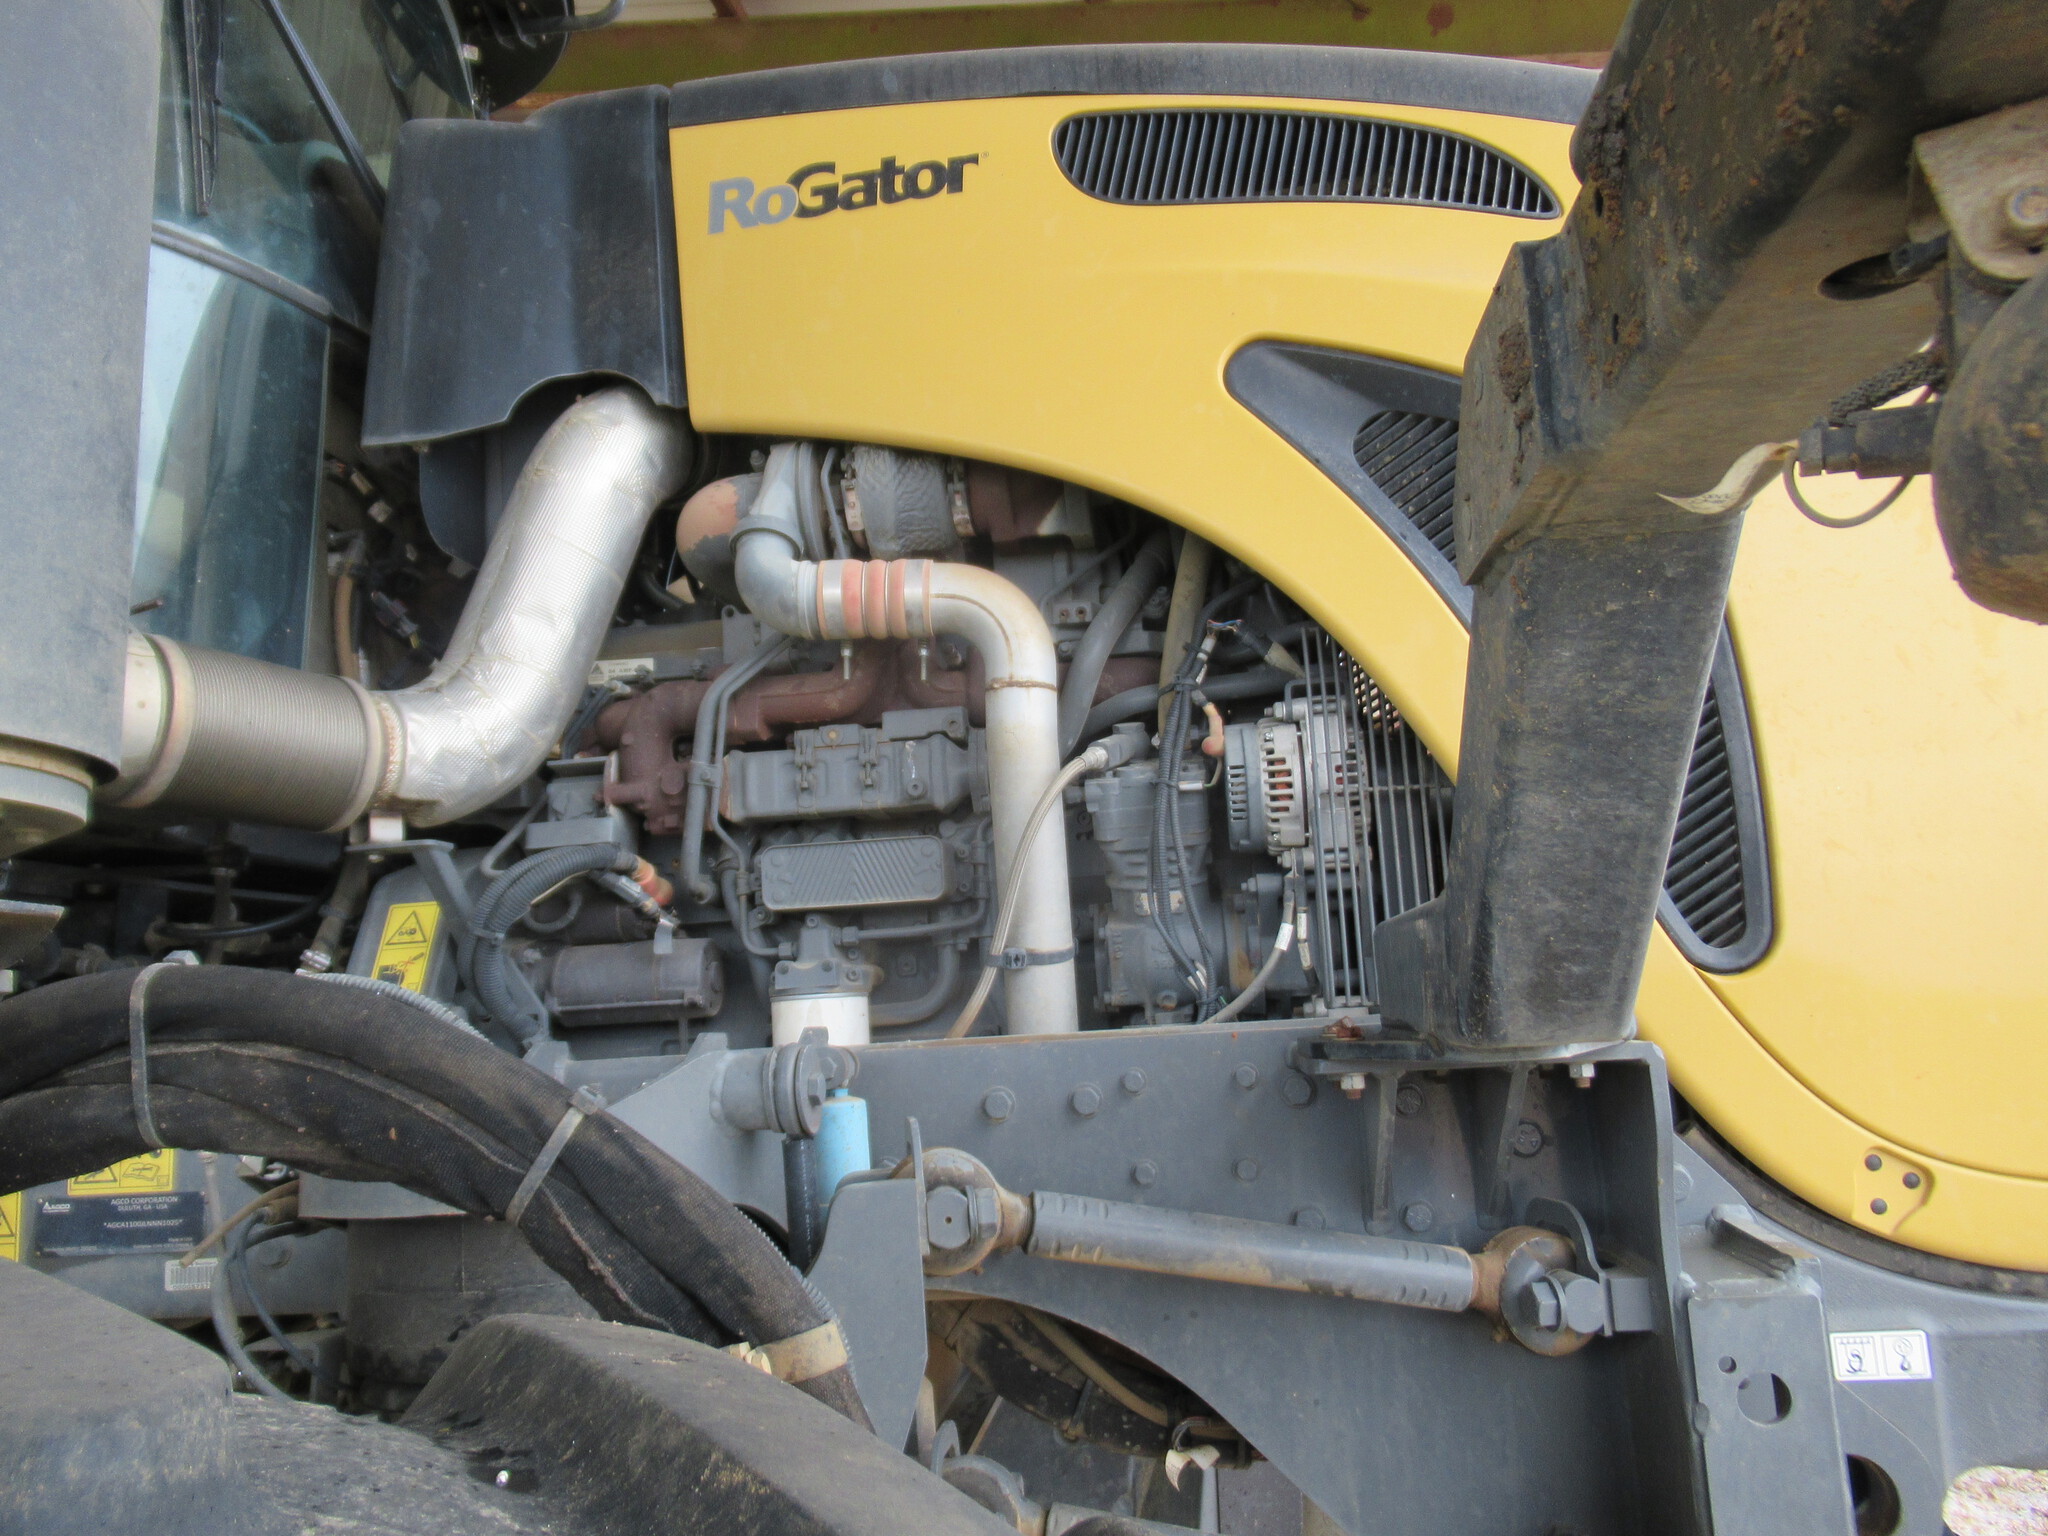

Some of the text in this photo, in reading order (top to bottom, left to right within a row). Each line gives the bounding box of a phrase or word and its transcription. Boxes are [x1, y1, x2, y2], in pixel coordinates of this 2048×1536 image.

[707, 152, 980, 235] RoGator
[110, 1195, 178, 1205] AGCO CORPORATION
